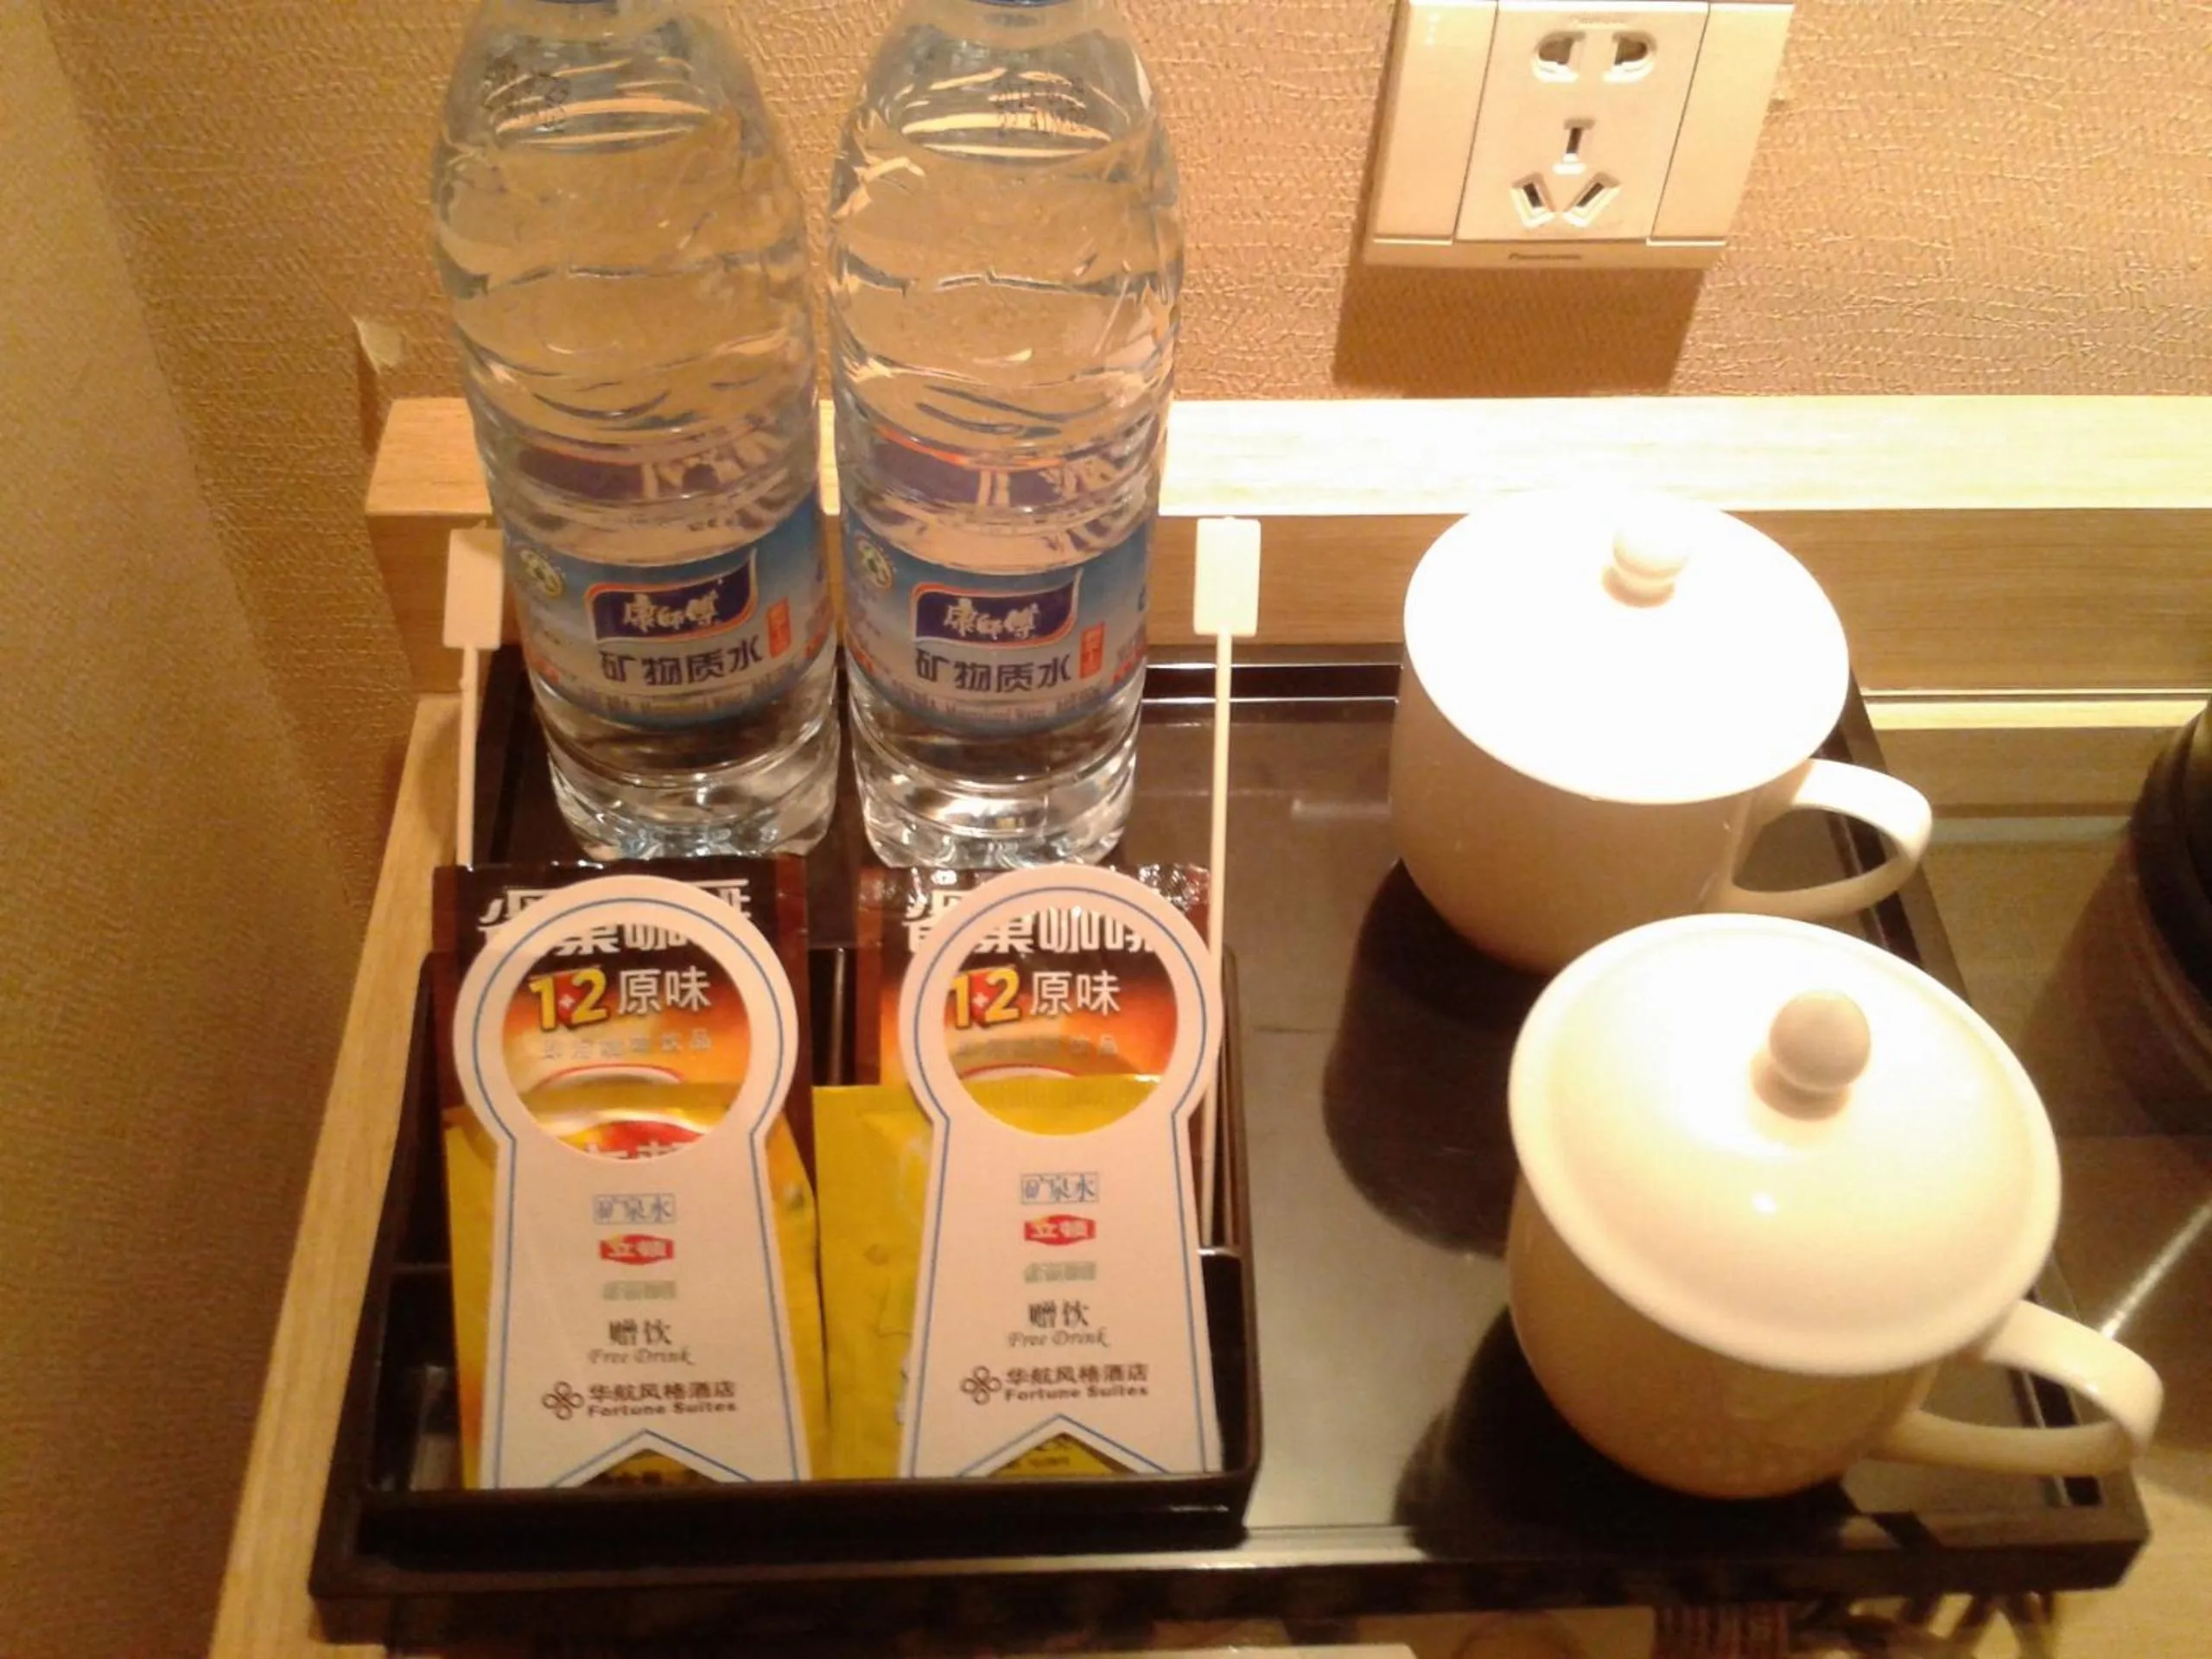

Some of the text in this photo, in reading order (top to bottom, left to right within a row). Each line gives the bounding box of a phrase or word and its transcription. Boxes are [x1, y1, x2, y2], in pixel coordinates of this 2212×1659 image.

[600, 636, 763, 686] 矿物质水
[915, 648, 1071, 693] 矿物质水
[1028, 1300, 1089, 1327] 赠饮
[609, 1319, 672, 1345] 赠饮
[1005, 1385, 1148, 1401] Fortune Suites
[588, 1402, 736, 1416] Fortune Suites
